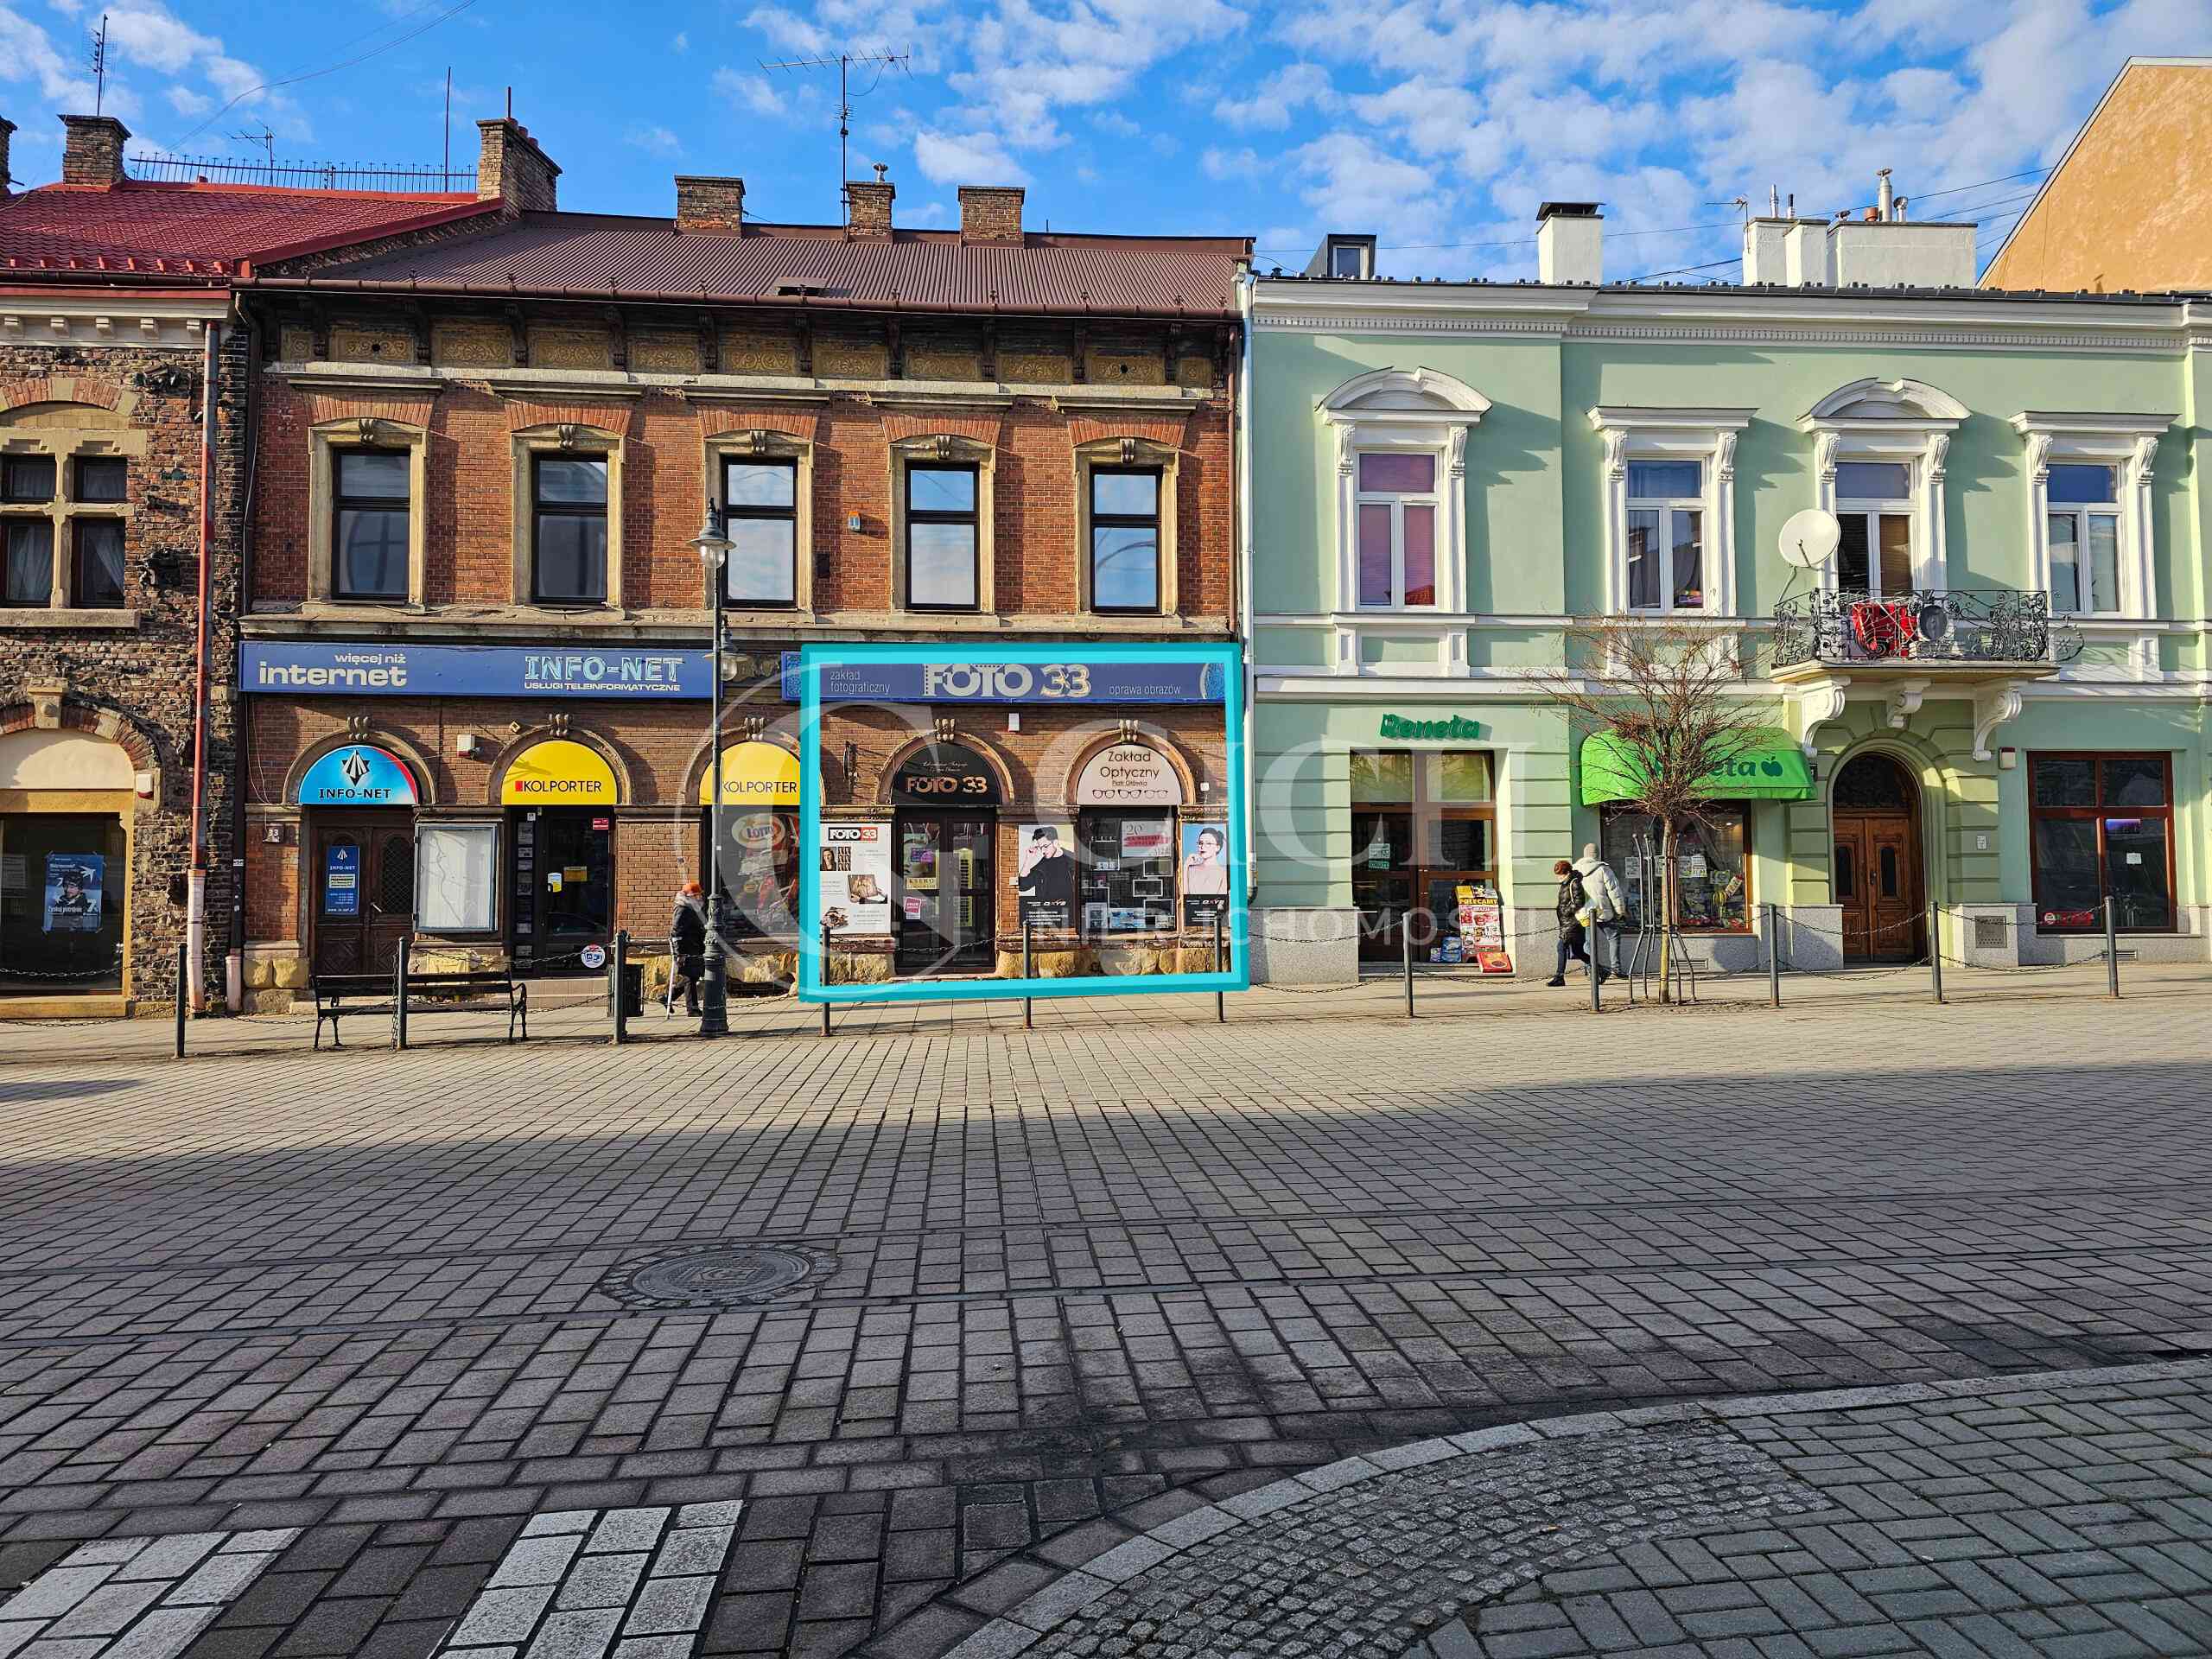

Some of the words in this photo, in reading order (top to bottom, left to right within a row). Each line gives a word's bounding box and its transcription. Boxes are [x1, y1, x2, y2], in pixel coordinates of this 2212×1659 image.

[335, 653, 382, 665] więcej
[384, 653, 406, 664] niż
[259, 661, 407, 687] internet
[524, 656, 684, 682] INFO-NET
[830, 670, 861, 681] zakład
[923, 663, 1033, 697] FOTO
[1039, 664, 1091, 697] 33
[564, 683, 681, 691] TELEINFORMATYCZNE
[830, 681, 891, 695] fotograficzny
[1109, 687, 1141, 698] oprawa
[1144, 684, 1181, 695] obrazów
[1380, 714, 1480, 740] Reneta
[1108, 751, 1152, 762] Zakład
[1100, 766, 1160, 779] Optyczny
[524, 780, 602, 792] KOLPORTER
[906, 776, 958, 793] FOTO
[962, 776, 988, 793] 33
[319, 788, 391, 798] INFO-NET
[829, 830, 861, 840] FOTO
[861, 830, 878, 839] 33
